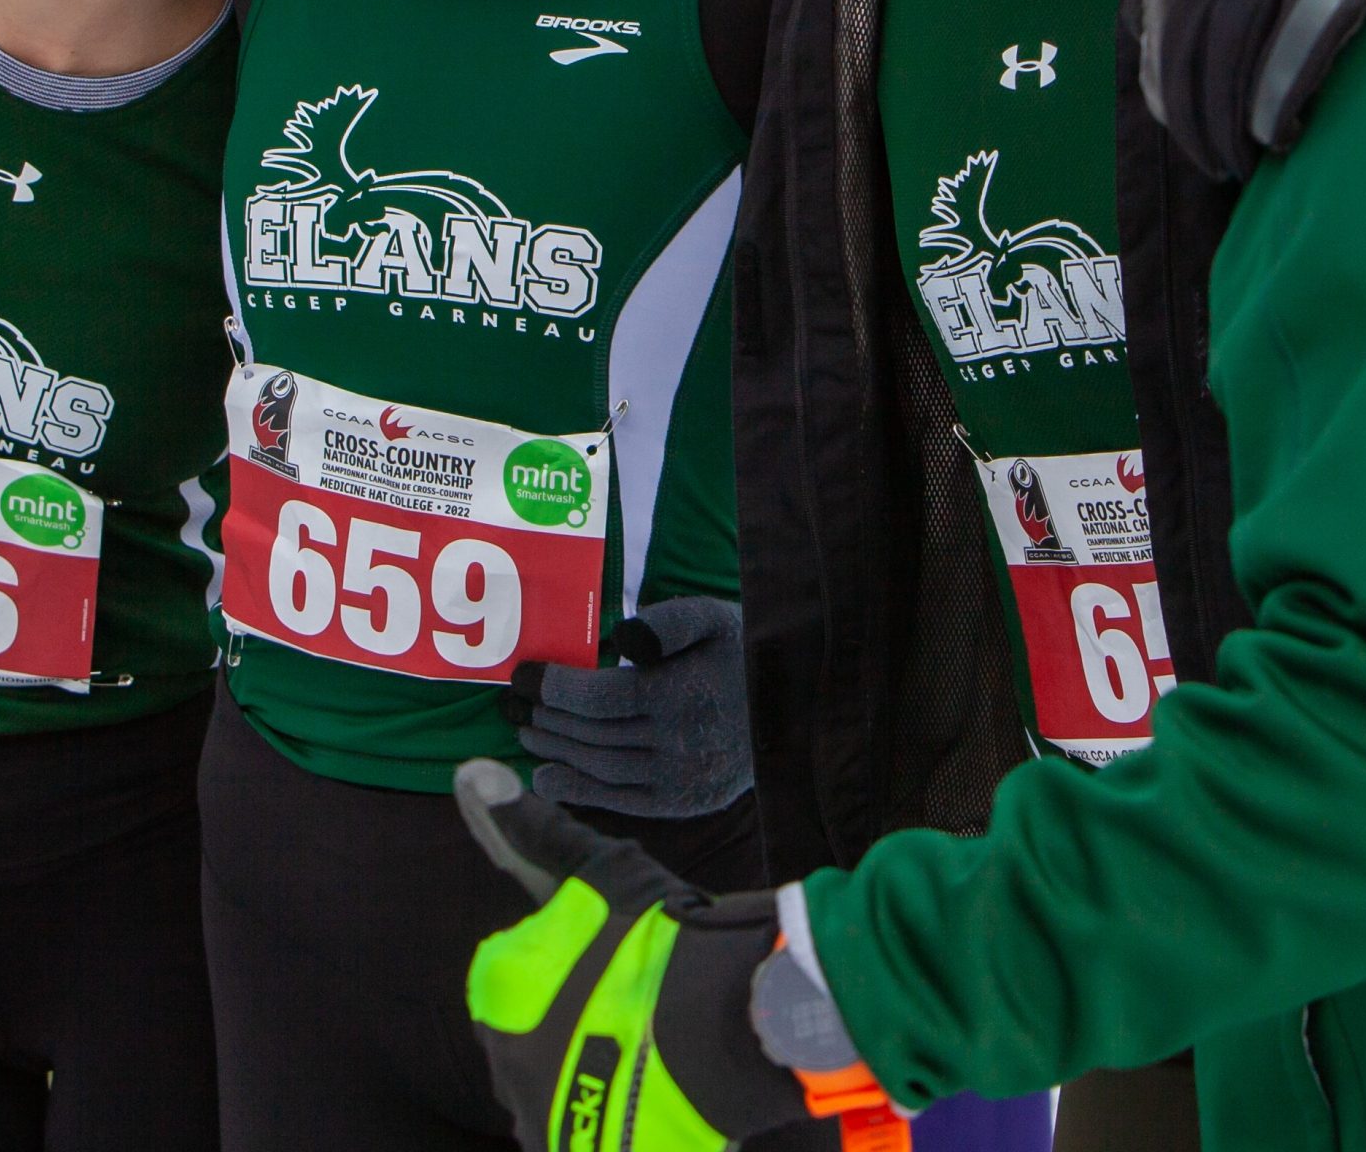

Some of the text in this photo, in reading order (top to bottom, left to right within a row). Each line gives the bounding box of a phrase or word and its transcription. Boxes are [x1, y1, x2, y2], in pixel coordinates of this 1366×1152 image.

[535, 14, 640, 35] BROOKS
[245, 196, 602, 317] ELANS
[247, 291, 595, 342] CÉGEP GARNEAU
[323, 409, 475, 446] CCAA ACSC
[324, 429, 476, 477] CROSS-COUNTRY
[322, 462, 473, 501] CHAMPIONNAT CANADIEN DE CROSS-COUNTRY
[323, 448, 473, 490] NATIONAL CHAMPIONSHIP
[512, 463, 583, 493] mint
[1069, 477, 1115, 488] CCAA
[8, 495, 78, 522] mint
[320, 477, 471, 518] MEDICINE HAT COLLEGE 2022
[516, 488, 576, 504] smartwash
[1077, 498, 1149, 522] CROSS-C
[14, 513, 70, 531] smartwash
[1081, 521, 1131, 535] NATIONAL
[1126, 534, 1151, 544] CANAD
[1092, 549, 1152, 563] MEDICINE HAT
[269, 499, 522, 668] 659
